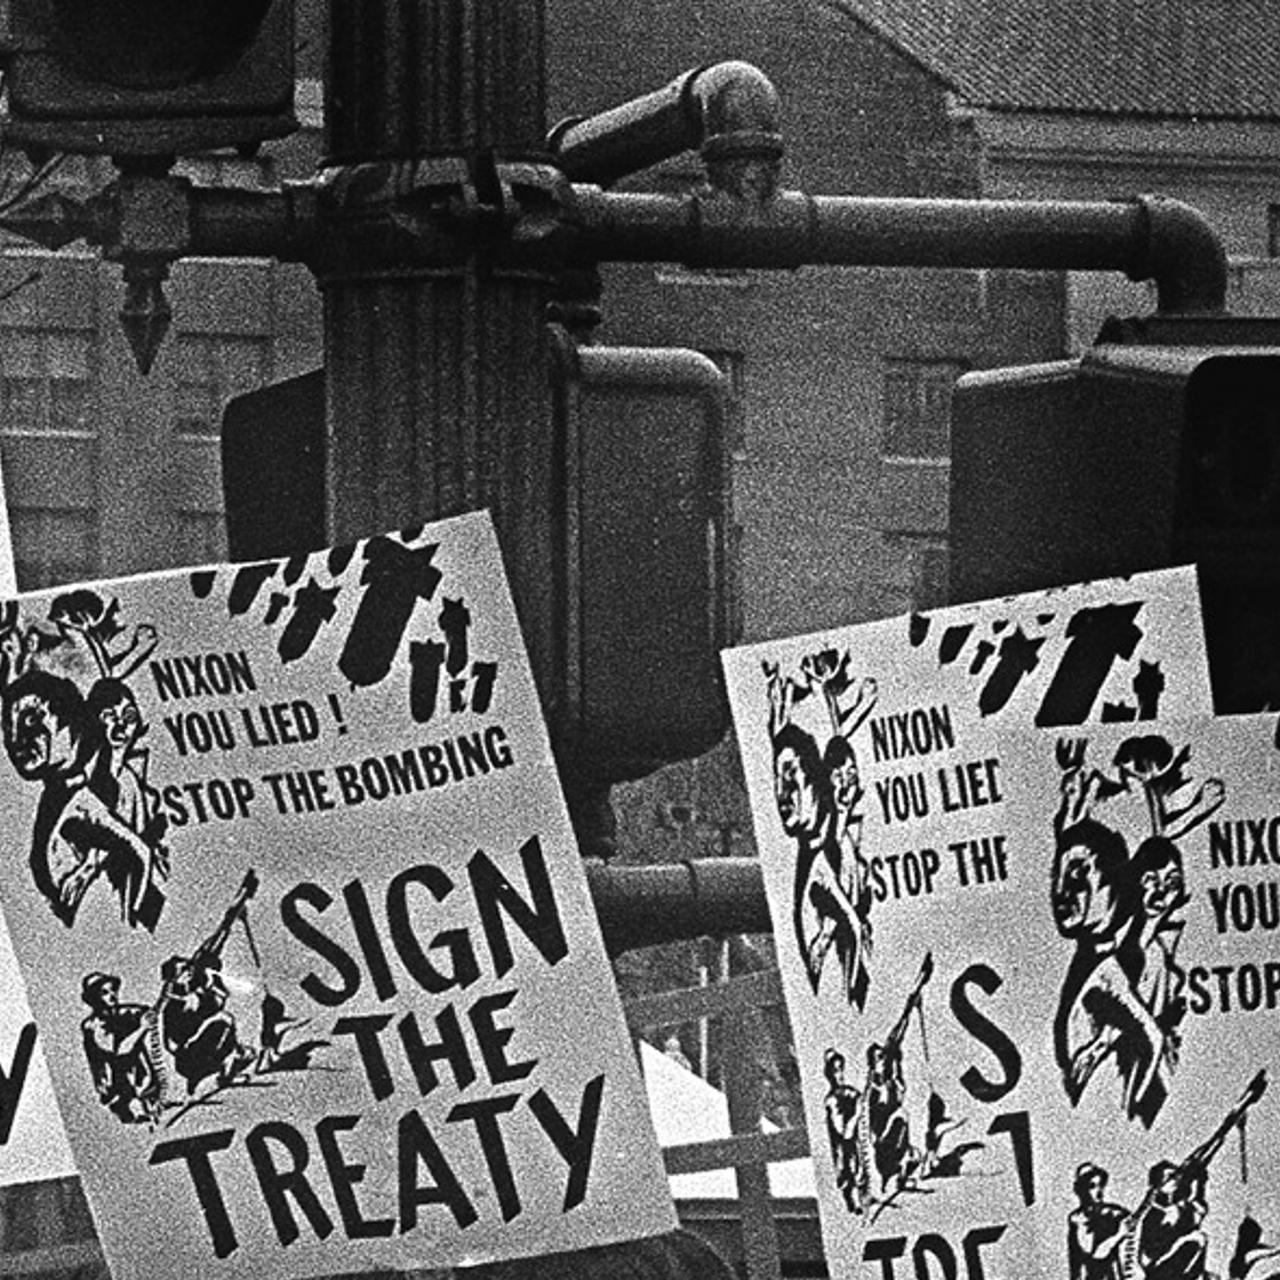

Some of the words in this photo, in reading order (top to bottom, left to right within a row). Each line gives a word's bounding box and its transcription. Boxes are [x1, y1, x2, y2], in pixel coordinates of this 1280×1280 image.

[150, 652, 256, 701] NIXON
[164, 709, 236, 755] YOU
[241, 700, 319, 748] LIED
[870, 704, 954, 762] NIXON
[163, 777, 255, 826] STOP
[261, 770, 336, 814] THE
[335, 726, 515, 806] BOMBING
[876, 772, 929, 824] YOU
[1209, 816, 1280, 868] NIXO
[871, 849, 940, 902] STOP
[279, 834, 568, 1006] SIGN
[1209, 882, 1280, 934] YOU
[332, 990, 539, 1102] THE
[148, 1075, 605, 1259] TREATY
